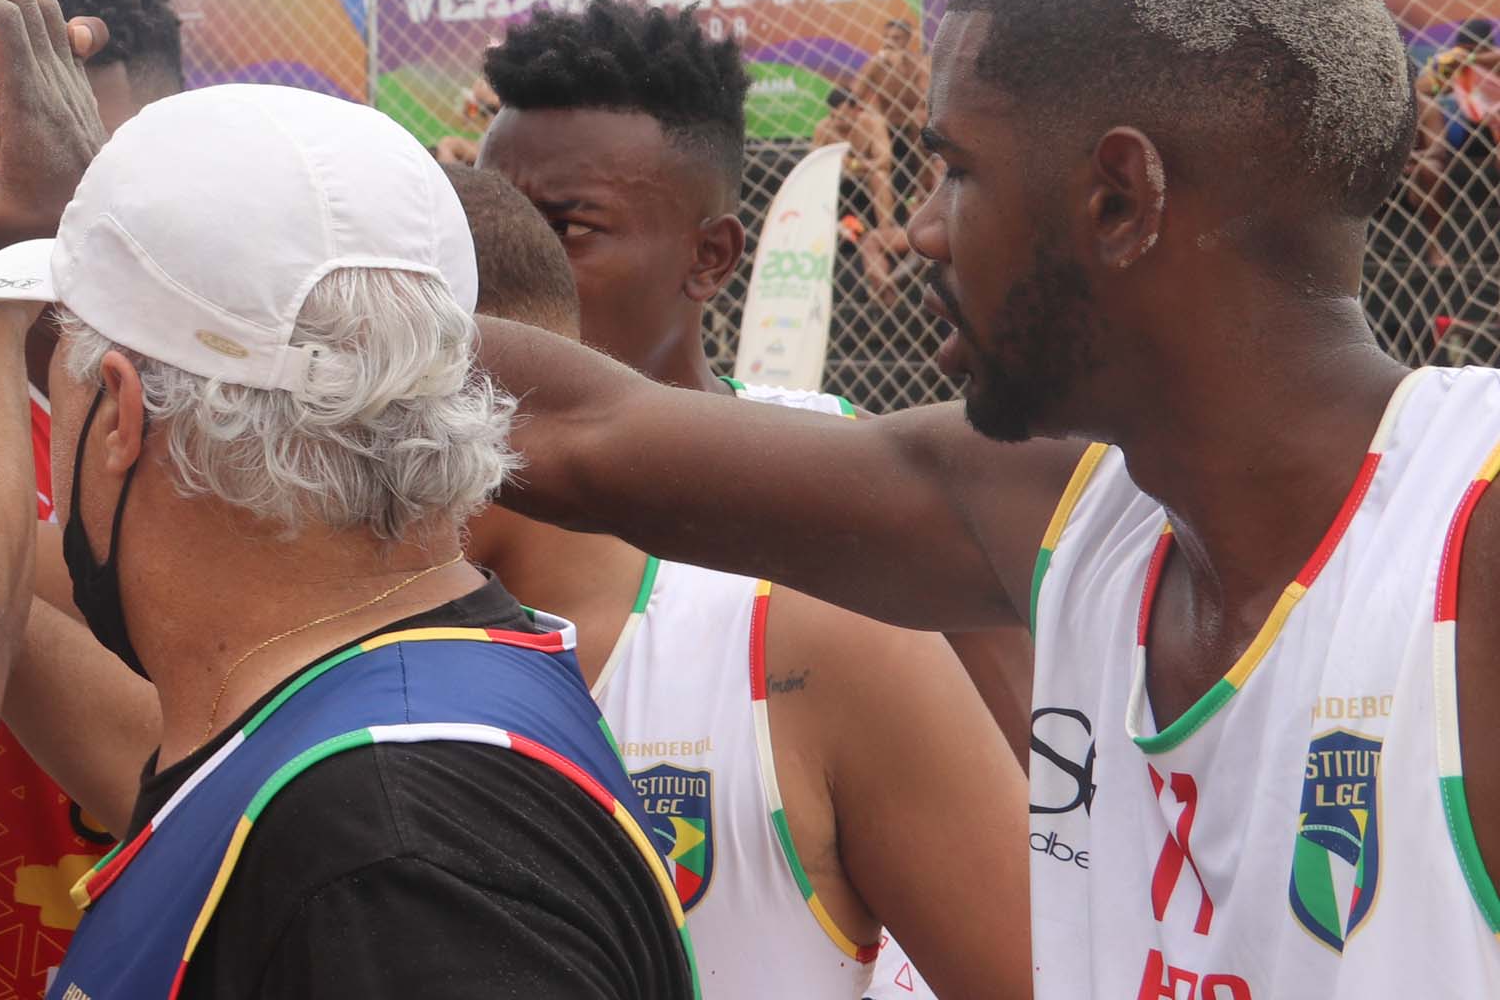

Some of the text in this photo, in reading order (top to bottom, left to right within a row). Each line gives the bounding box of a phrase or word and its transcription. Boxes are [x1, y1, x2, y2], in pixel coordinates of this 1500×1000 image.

[1305, 749, 1381, 780] STITUT
[632, 775, 706, 798] STITUTO
[1315, 782, 1368, 807] LGC
[643, 798, 684, 815] LGC
